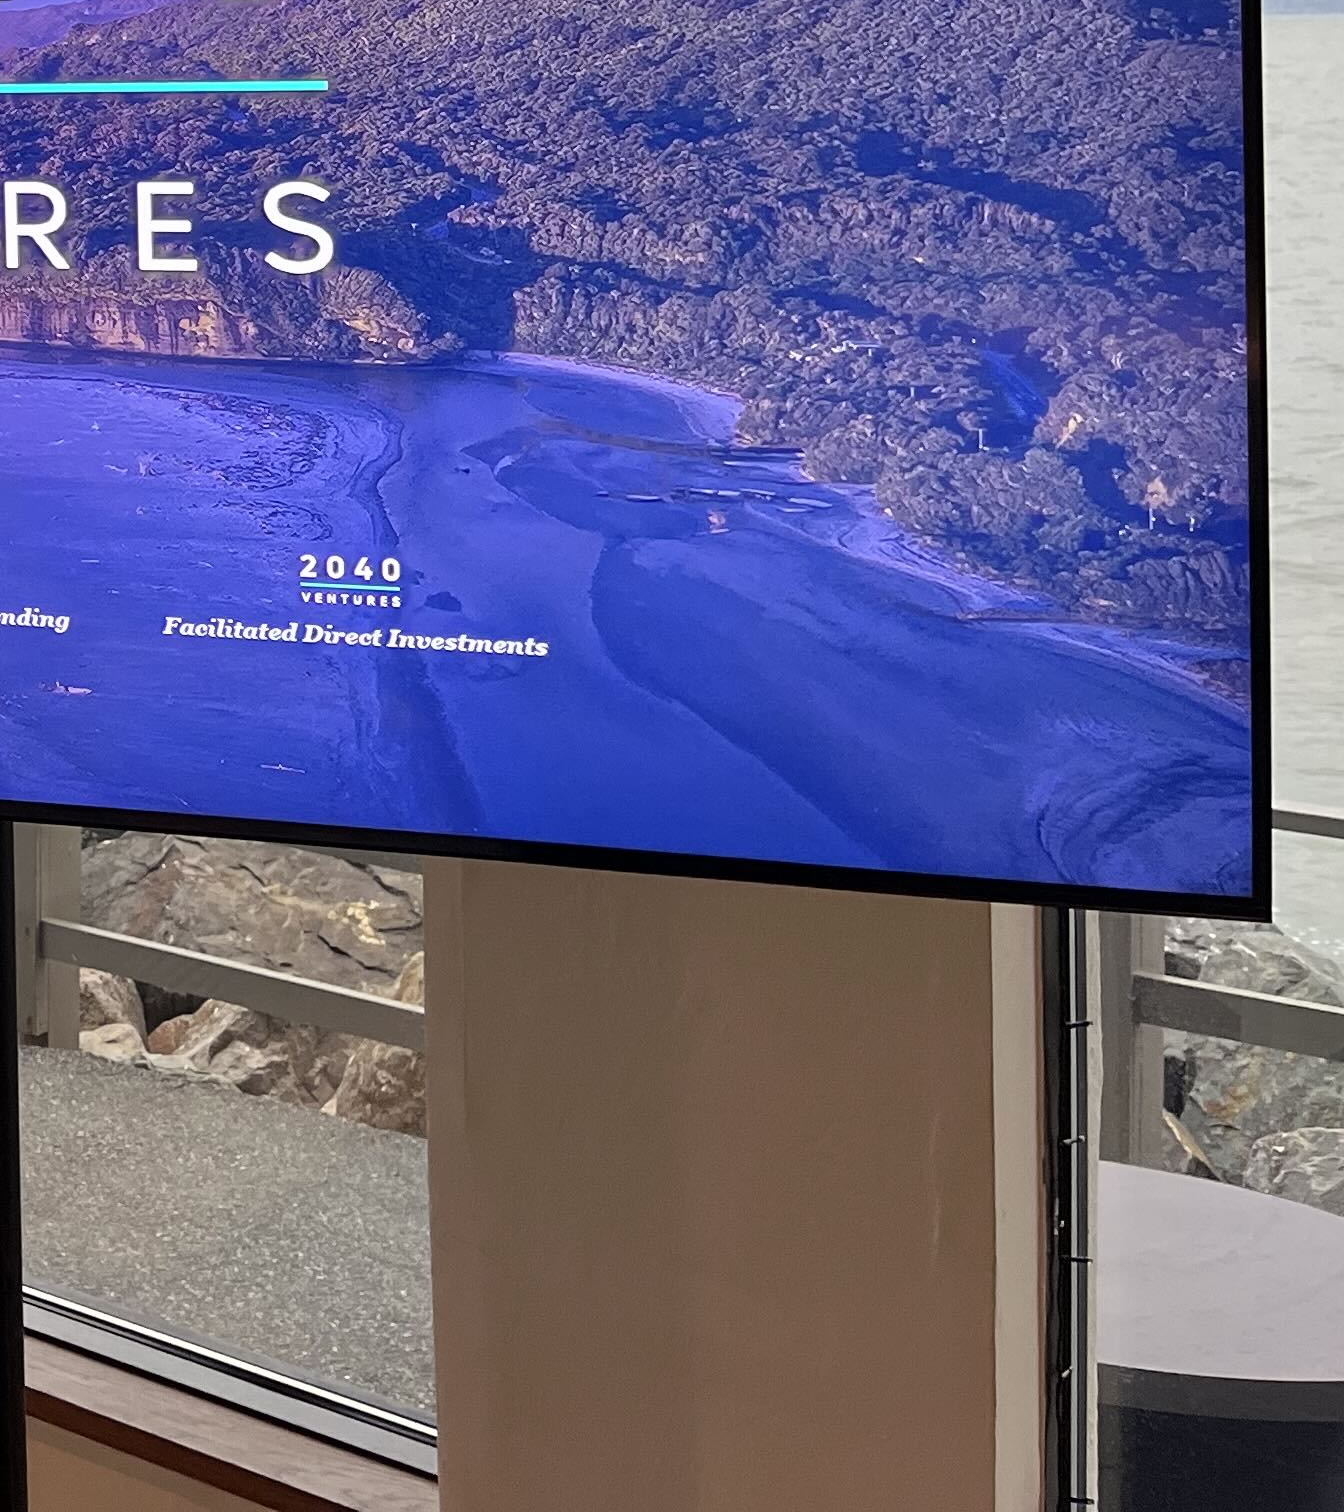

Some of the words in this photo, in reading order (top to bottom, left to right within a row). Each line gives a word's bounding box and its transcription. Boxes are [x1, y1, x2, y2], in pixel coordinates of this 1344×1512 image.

[299, 554, 401, 582] 2040
[301, 591, 401, 608] VENTURES
[162, 616, 299, 642] Facilitated
[301, 624, 383, 647] Direct
[385, 629, 549, 657] Investments
